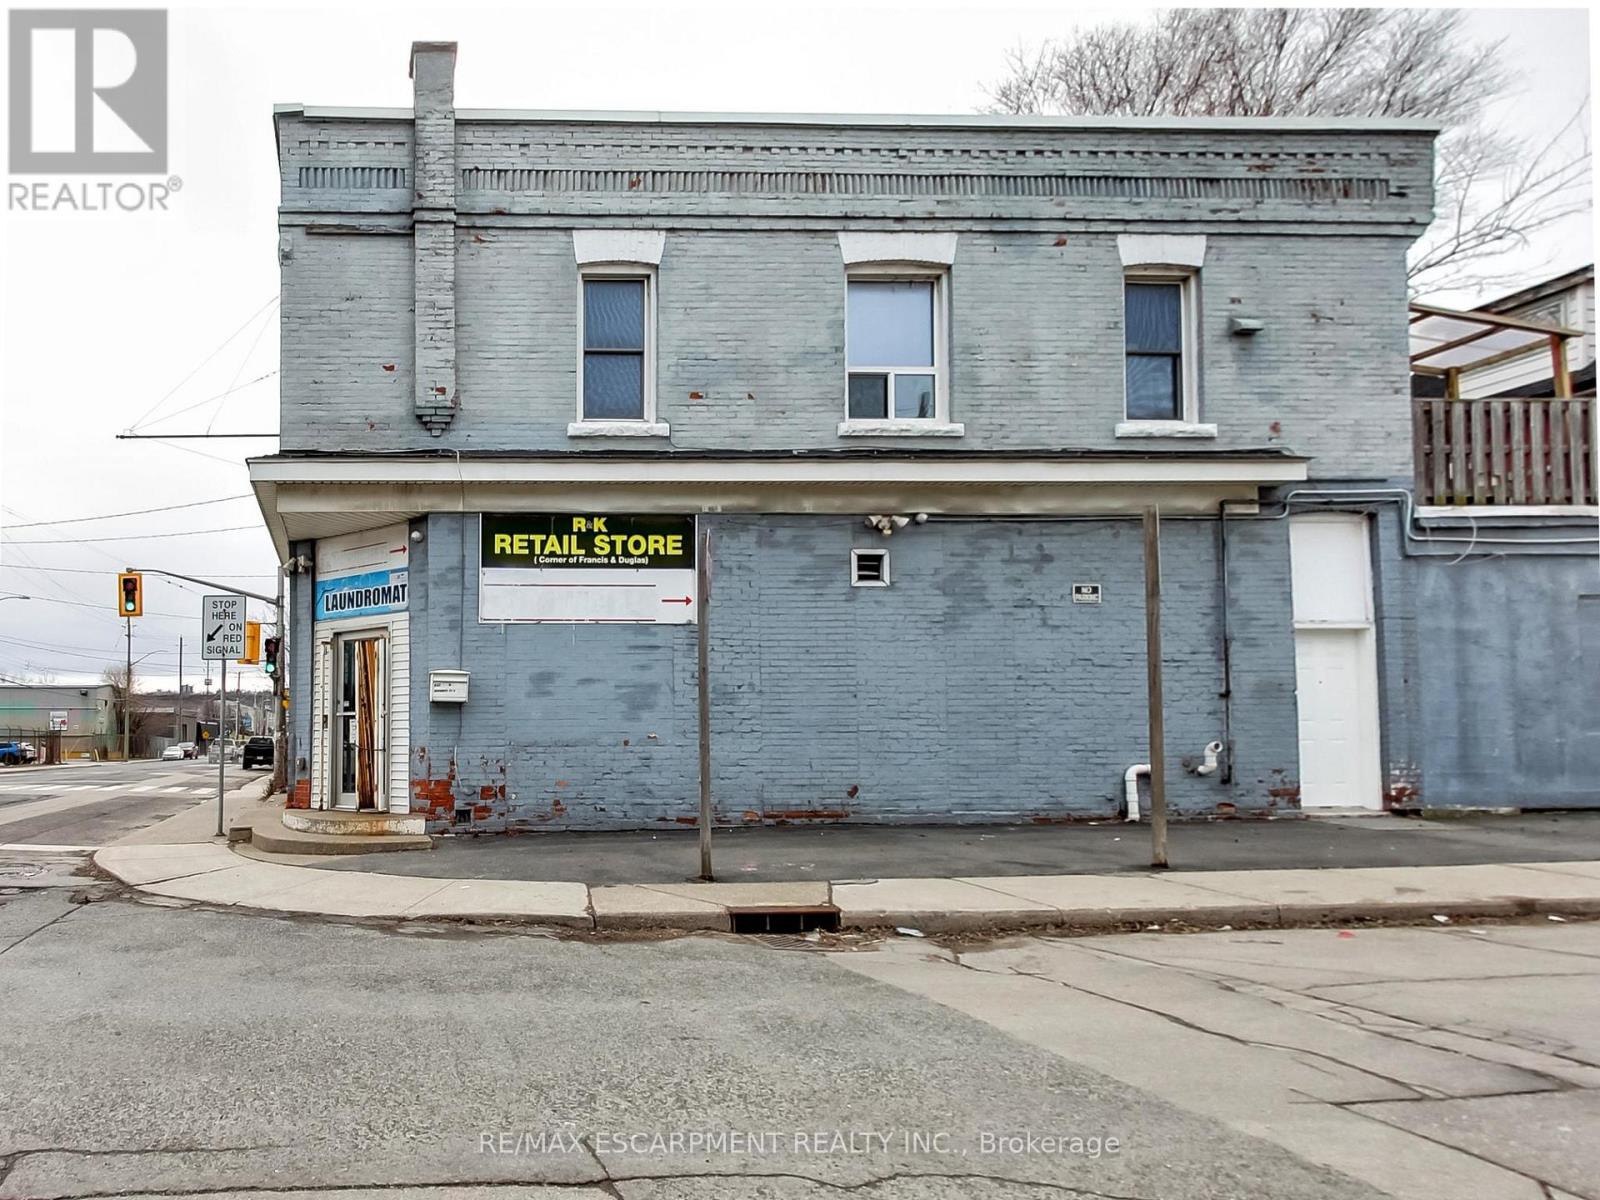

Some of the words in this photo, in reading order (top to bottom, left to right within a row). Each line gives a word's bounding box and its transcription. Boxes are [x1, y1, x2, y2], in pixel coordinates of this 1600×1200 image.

[494, 534, 586, 555] RETAIL
[594, 534, 683, 556] STORE
[569, 556, 578, 564] of
[579, 556, 609, 564] Francis
[610, 556, 617, 564] &
[325, 583, 408, 612] LAUNDROMAT
[212, 600, 237, 610] STOP
[211, 611, 237, 621] HERE
[228, 622, 243, 632] ON
[222, 633, 242, 643] RED
[206, 645, 241, 655] SIGNAL
